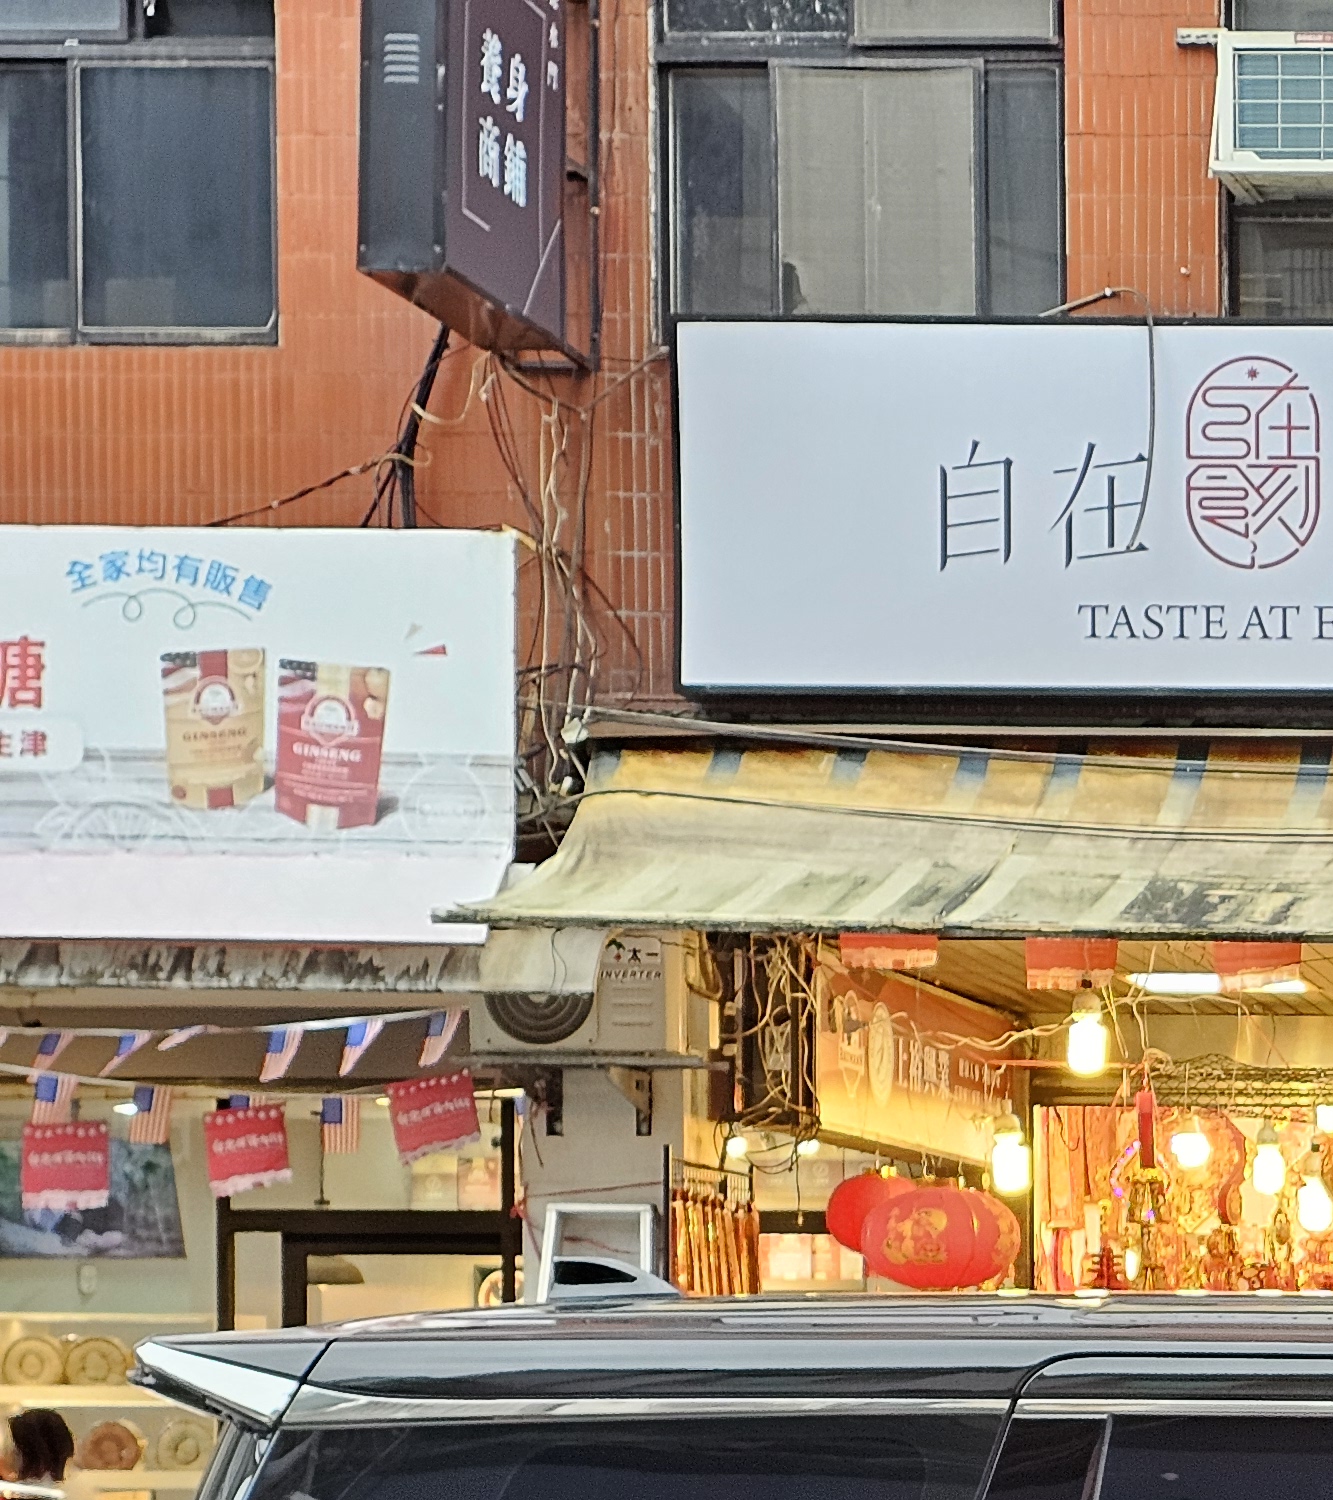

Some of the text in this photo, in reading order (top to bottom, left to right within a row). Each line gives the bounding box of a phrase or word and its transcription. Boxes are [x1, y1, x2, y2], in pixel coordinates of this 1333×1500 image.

[480, 28, 529, 122] 養身
[478, 115, 527, 207] 商鋪
[937, 439, 1151, 573] 自在
[65, 548, 273, 611] 全家均有販售
[1077, 604, 1228, 641] TASTE
[1237, 604, 1304, 641] AT
[293, 742, 362, 763] GINSENG
[600, 969, 661, 980] INVERTER
